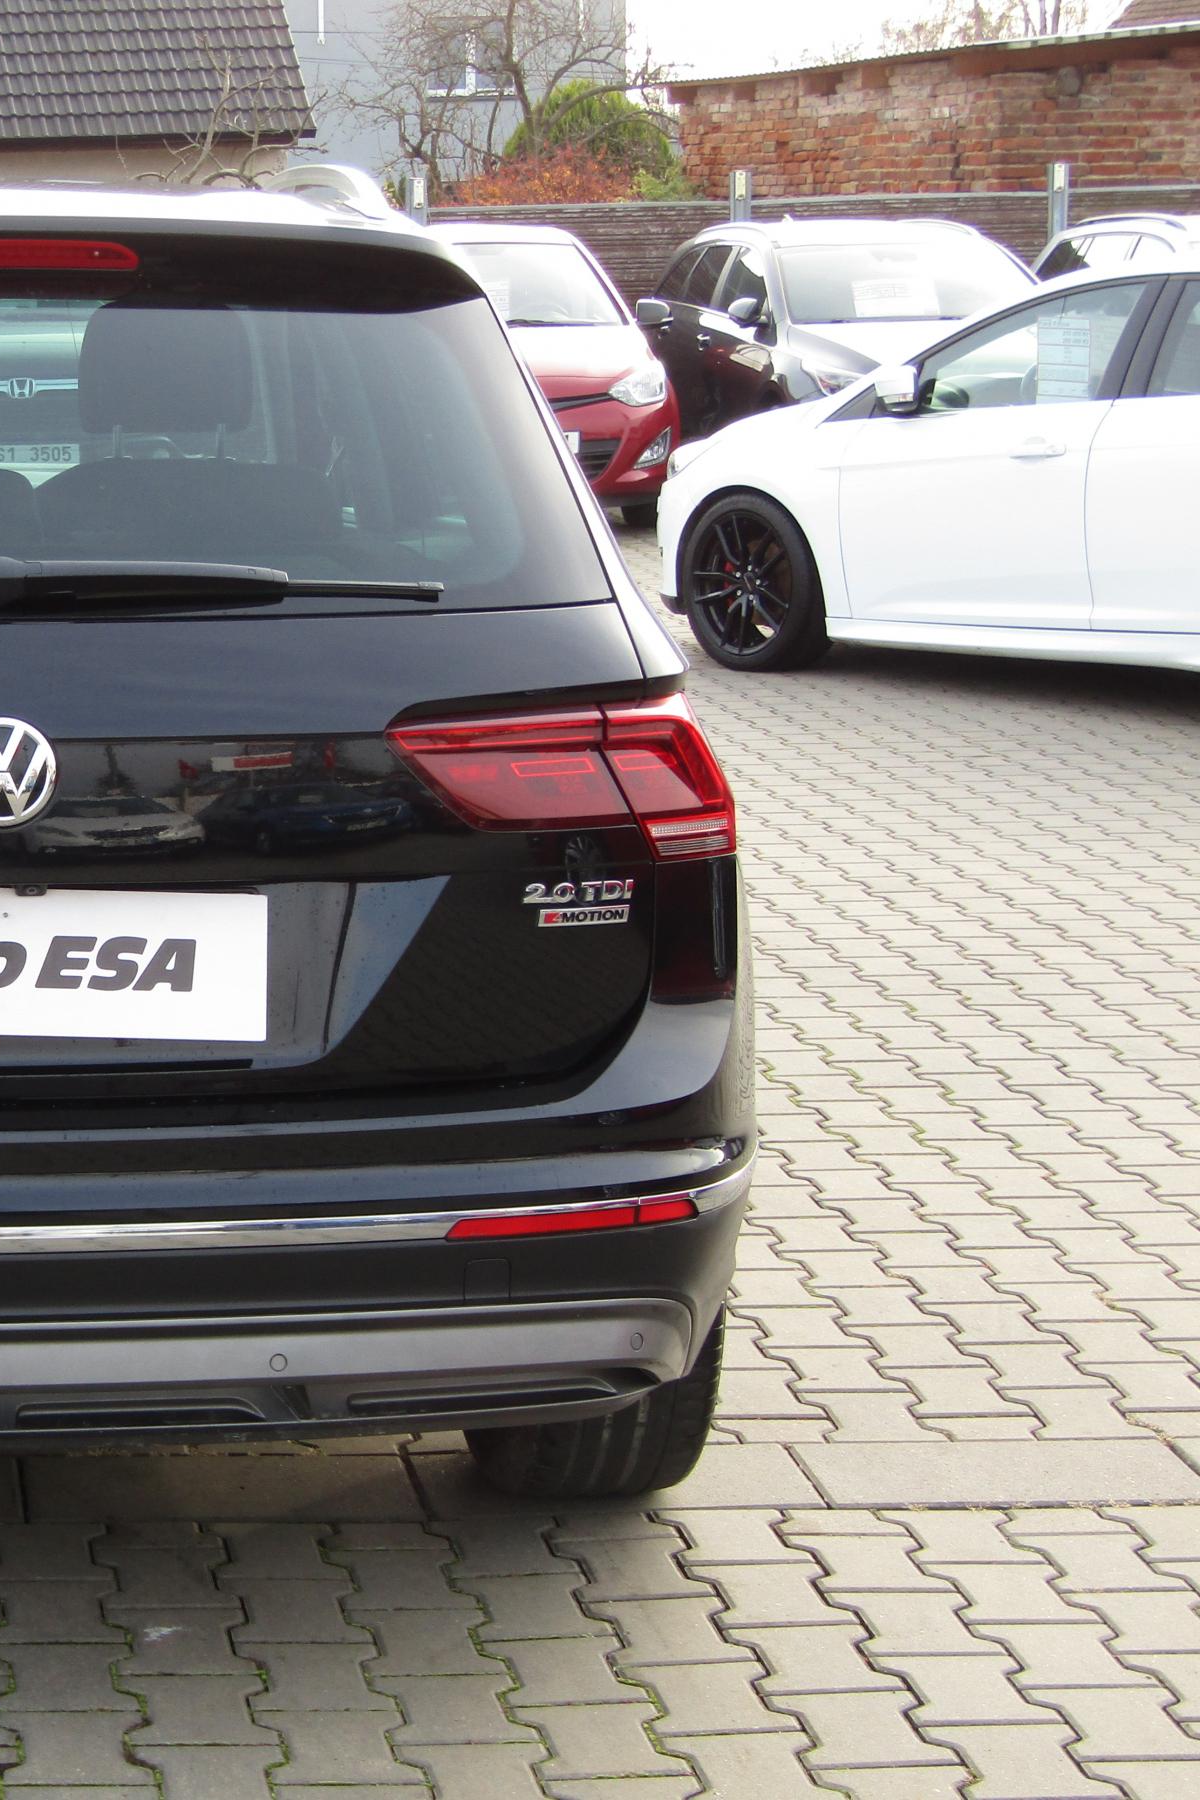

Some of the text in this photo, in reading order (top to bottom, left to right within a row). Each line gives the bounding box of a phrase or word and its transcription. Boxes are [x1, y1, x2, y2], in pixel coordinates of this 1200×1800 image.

[30, 446, 72, 462] 3505
[523, 879, 634, 904] 2.0 TDI
[35, 936, 197, 992] ESA
